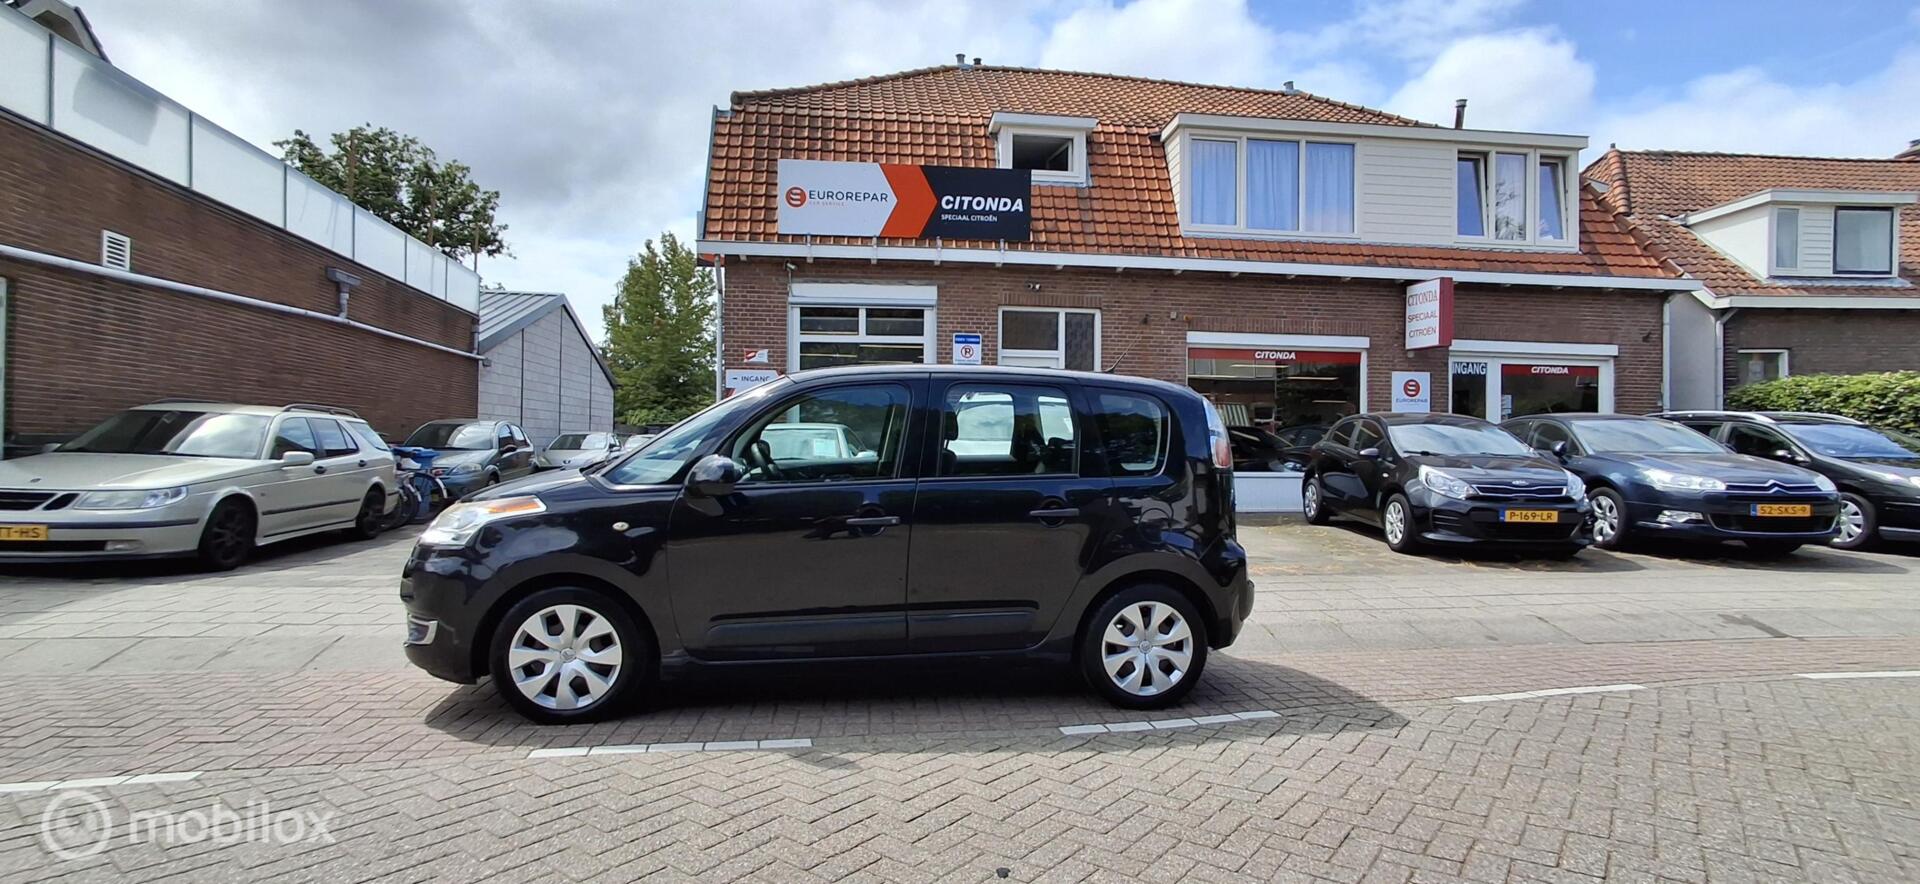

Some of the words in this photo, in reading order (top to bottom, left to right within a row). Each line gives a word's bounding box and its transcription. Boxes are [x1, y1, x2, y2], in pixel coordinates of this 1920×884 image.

[808, 189, 888, 203] EUROREPAR
[941, 195, 1024, 213] CITONDA
[941, 214, 970, 222] SPECIAAL
[1407, 290, 1438, 307] CITONDA
[1407, 310, 1438, 323] SPECIAAL
[1254, 351, 1297, 360] CITONDA
[1451, 361, 1487, 375] INGANG
[1530, 366, 1569, 374] CITONDA
[1760, 505, 1807, 515] 52-SKS-9
[1509, 511, 1553, 521] P-169-LR
